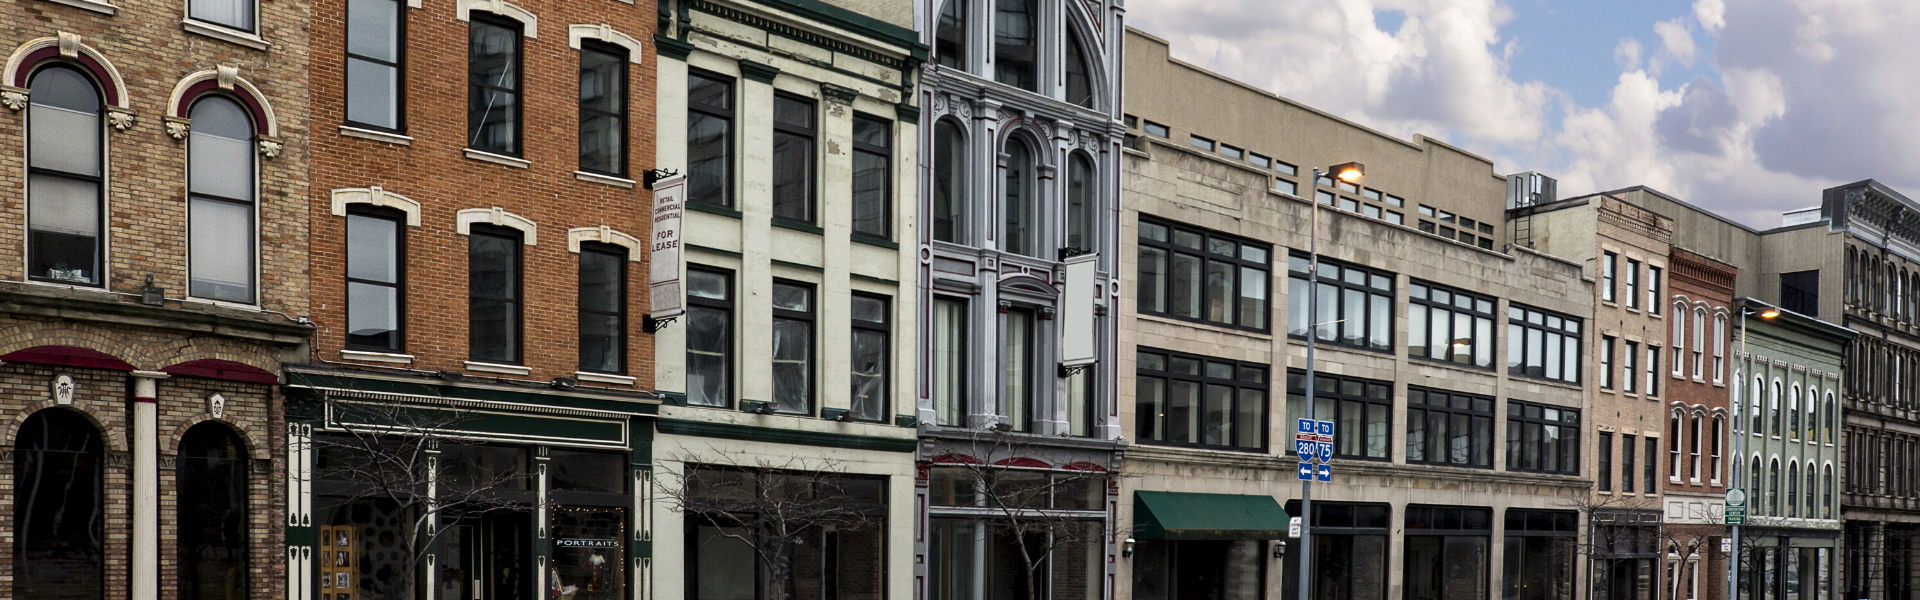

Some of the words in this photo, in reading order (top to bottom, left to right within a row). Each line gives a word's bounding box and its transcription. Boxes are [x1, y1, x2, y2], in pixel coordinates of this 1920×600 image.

[660, 195, 674, 204] RETAIL
[655, 203, 680, 214] COMMERCIAL
[655, 212, 679, 223] RESIDENTIAL
[657, 230, 673, 240] FOR
[652, 240, 678, 252] LEASE
[1302, 421, 1310, 430] TO
[1321, 424, 1329, 433] TO
[1298, 442, 1314, 455] 280
[1319, 444, 1330, 457] 75
